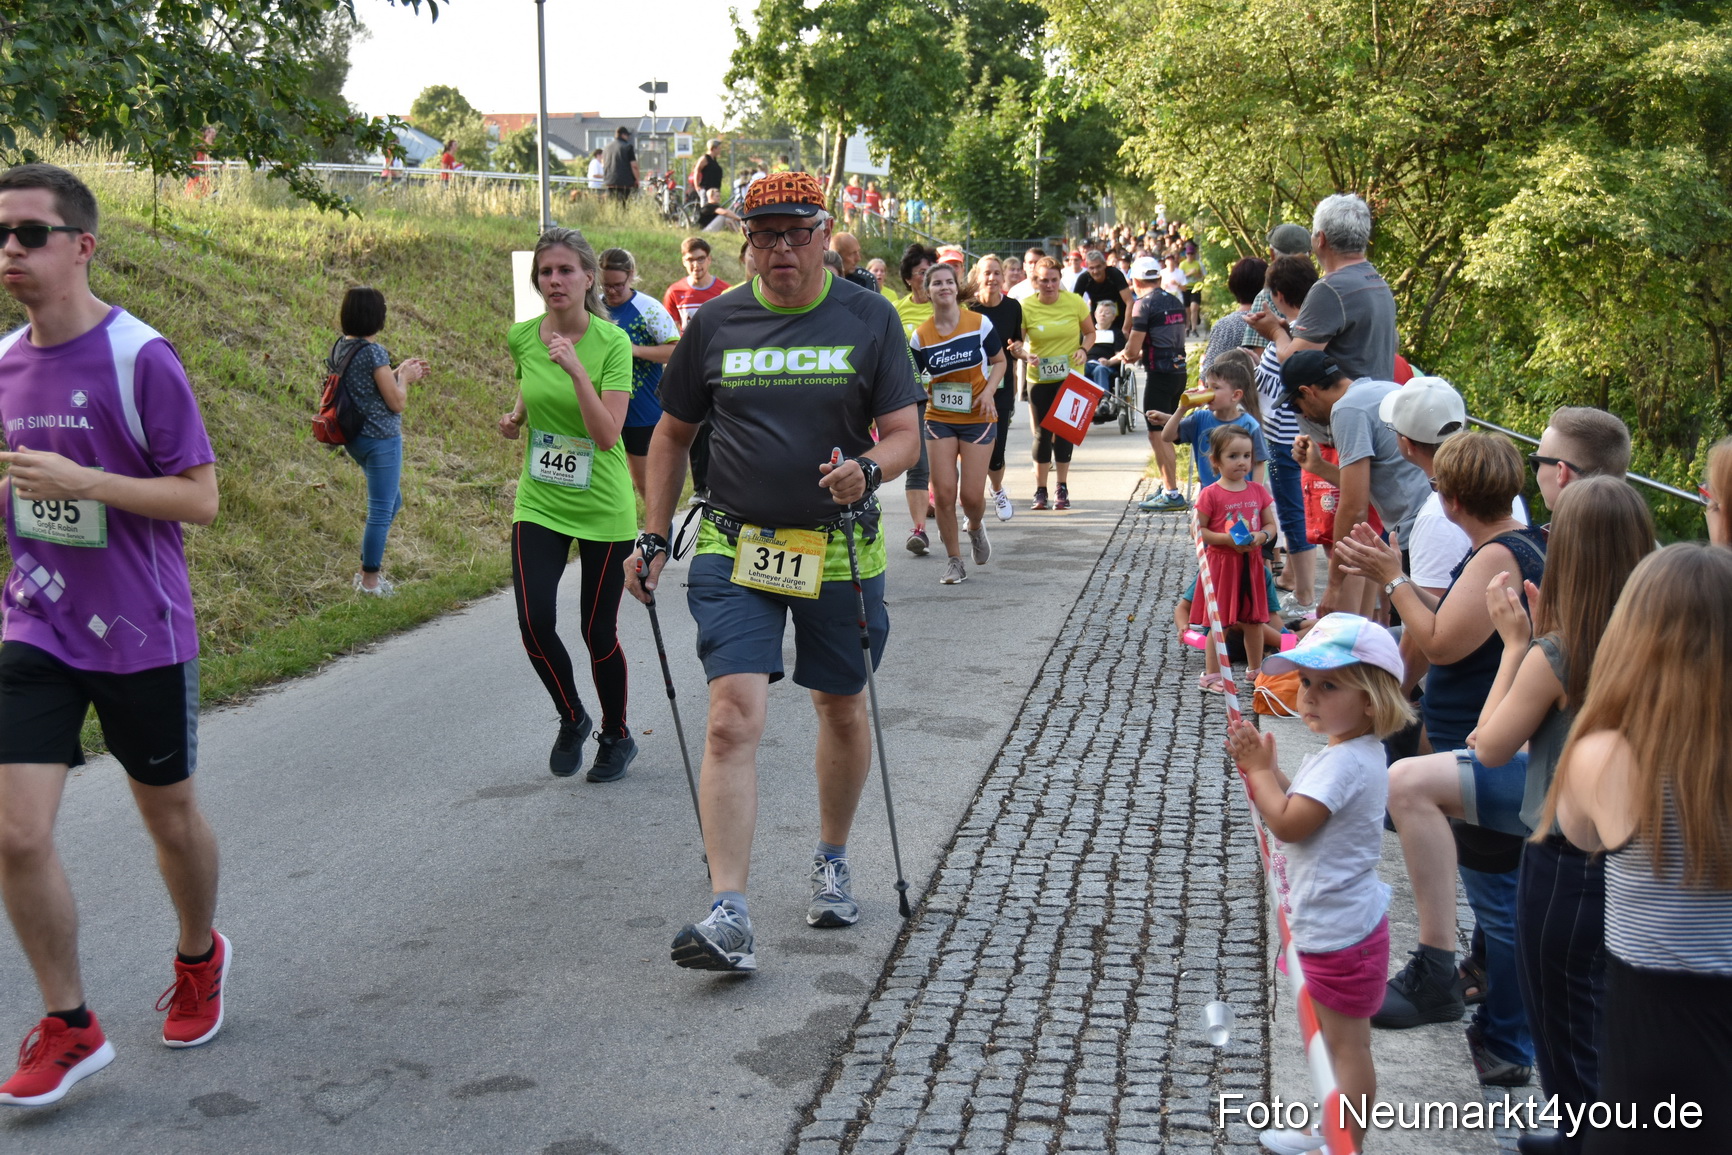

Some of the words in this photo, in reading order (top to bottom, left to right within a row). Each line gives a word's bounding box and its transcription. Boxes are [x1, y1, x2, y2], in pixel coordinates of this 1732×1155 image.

[723, 347, 852, 376] BOCK
[936, 350, 973, 366] Fischer
[1041, 364, 1065, 375] 1304
[721, 377, 756, 389] inspired
[758, 377, 770, 388] by
[773, 377, 802, 386] smart
[804, 376, 848, 387] concepts
[940, 393, 963, 406] 9138
[6, 417, 25, 432] WIR
[28, 415, 56, 429] SIND
[58, 415, 94, 430] LILA.
[540, 451, 577, 473] 446
[552, 470, 575, 479] Vanessa
[32, 499, 81, 524] 895
[57, 523, 79, 533] Robin
[753, 547, 803, 578] 311
[748, 569, 781, 582] Lehmeyer
[782, 576, 806, 586] Jürgen
